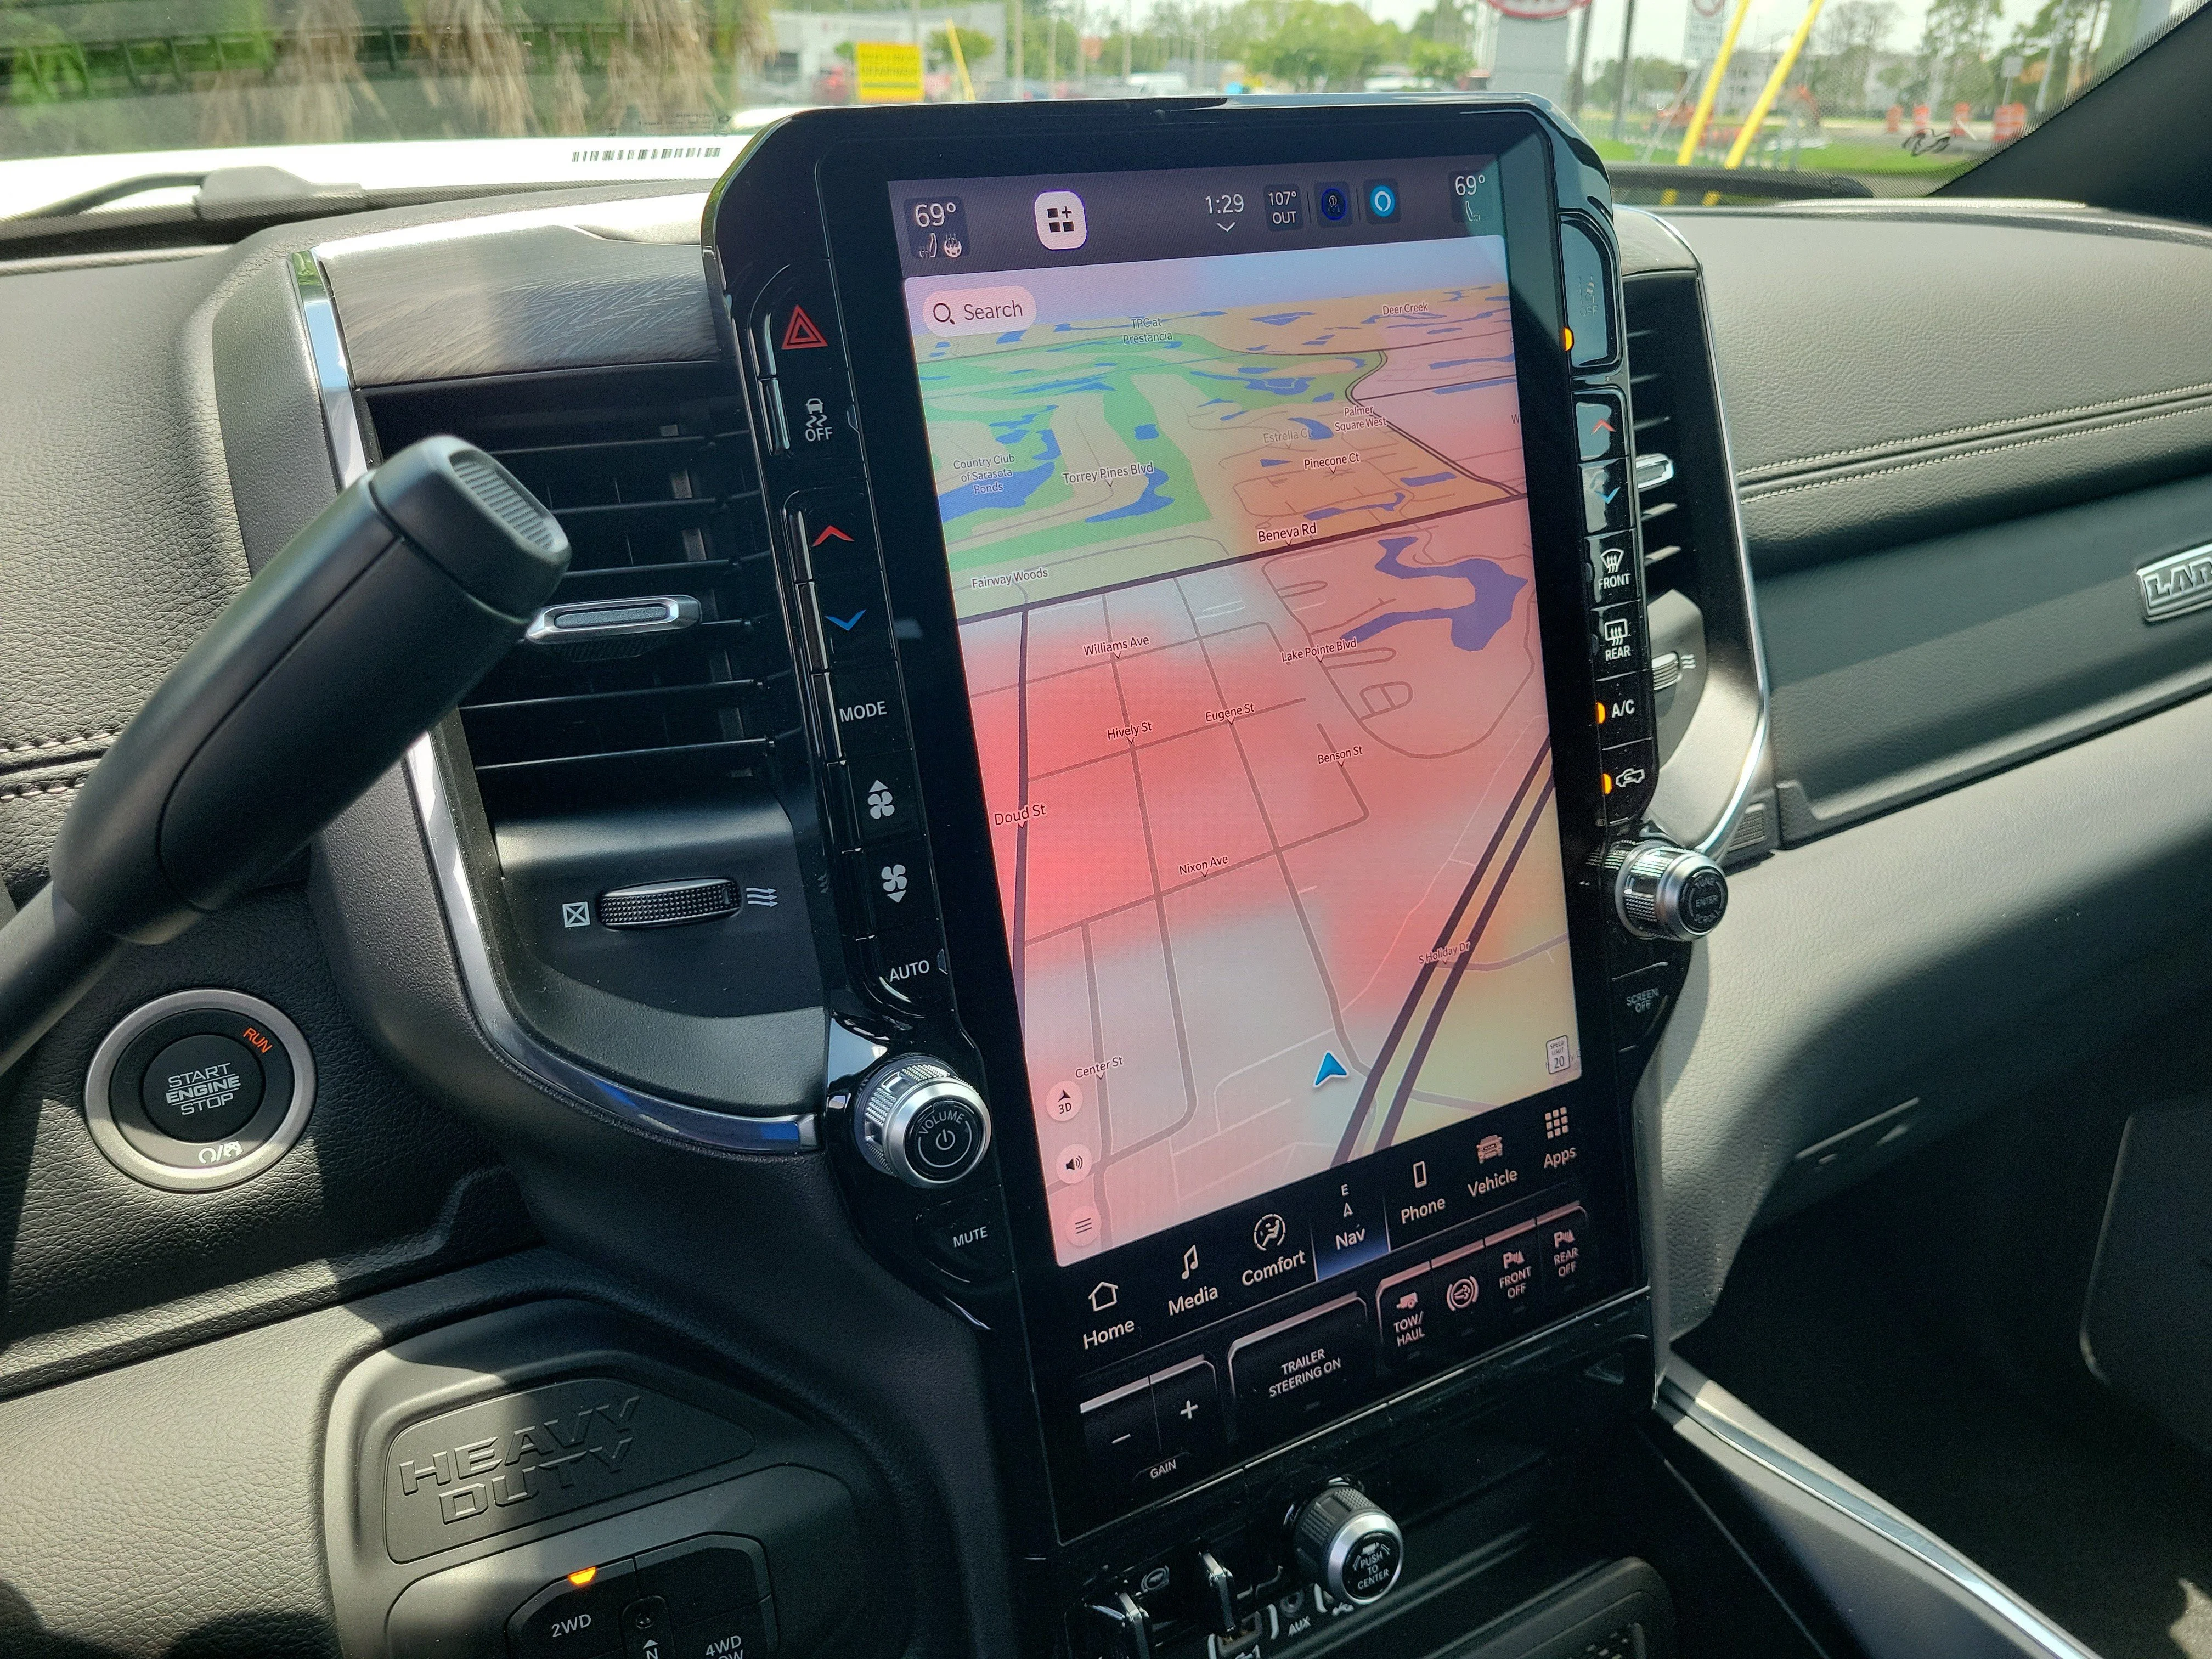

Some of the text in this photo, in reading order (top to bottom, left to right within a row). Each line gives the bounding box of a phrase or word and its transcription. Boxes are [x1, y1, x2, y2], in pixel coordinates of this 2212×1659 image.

[1455, 174, 1486, 196] 69°
[1205, 194, 1244, 215] 1:29
[1268, 191, 1297, 206] 107°
[915, 201, 957, 227] 69°
[1272, 211, 1297, 225] OUT
[963, 300, 1023, 321] Search
[1383, 302, 1429, 315] Deer Creek
[1580, 305, 1598, 317] OFF
[1130, 318, 1162, 329] TPC at
[1123, 331, 1173, 345] Prestancia
[1344, 405, 1374, 417] Palmer
[805, 427, 833, 442] OFF
[1334, 416, 1387, 432] Square West
[1263, 428, 1312, 443] Estrella Ct
[953, 454, 1015, 470] Country Club
[1304, 453, 1359, 470] Pinecone Ct
[961, 469, 1013, 482] of Sarasota
[1063, 462, 1154, 486] Torrey Pines Blvd
[974, 482, 1003, 494] Ponds
[1258, 523, 1317, 543] Beneva Rd
[972, 568, 1048, 589] Fairway Woods
[1598, 573, 1631, 590] FRONT
[1084, 636, 1149, 657] Williams Ave
[1282, 638, 1357, 663] Lake Pointe Blvd
[1605, 646, 1631, 661] REAR
[839, 701, 887, 723] MODE
[1206, 703, 1255, 723] Eugene St
[1612, 699, 1635, 718] A/C
[1107, 722, 1153, 740] Hively St
[1317, 746, 1363, 764] Benson St
[994, 804, 1046, 826] Doud St
[1179, 855, 1228, 876] Nixon Ave
[1419, 941, 1470, 964] S Holiday Dr
[889, 960, 929, 982] AUTO
[1626, 988, 1659, 1006] SCREEN
[1635, 1000, 1652, 1013] OFF
[242, 1027, 273, 1054] RUN
[1550, 1040, 1564, 1049] SPEED
[1551, 1047, 1564, 1056] LIMIT
[1075, 1056, 1123, 1079] Center St
[1554, 1056, 1565, 1069] 20
[168, 1062, 231, 1088] START
[166, 1075, 241, 1104] ENGINE
[181, 1092, 234, 1115] STOP
[1059, 1102, 1072, 1114] 3D
[919, 1110, 965, 1135] VOLUME
[1543, 1147, 1577, 1169] Apps
[1468, 1169, 1518, 1197] Vehicle
[1401, 1198, 1446, 1224] Phone
[953, 1226, 988, 1248] MUTE
[1335, 1227, 1366, 1250] Nav
[1554, 1247, 1579, 1266] REAR
[1242, 1250, 1306, 1286] Comfort
[1499, 1266, 1532, 1289] FRONT
[1558, 1262, 1577, 1277] OFF
[1168, 1286, 1218, 1316] Media
[1508, 1284, 1527, 1299] OFF
[1393, 1311, 1424, 1334] TOW/
[1082, 1320, 1135, 1350] Home
[1397, 1327, 1426, 1347] HAUL
[1281, 1348, 1325, 1375] TRAILER
[1269, 1358, 1342, 1398] STEERING ON
[400, 1395, 641, 1496] HEAVY
[1149, 1459, 1177, 1479] GAIN
[439, 1436, 633, 1525] DUTY
[1360, 1550, 1384, 1570] PUSH
[1367, 1564, 1379, 1576] TO
[1357, 1568, 1390, 1590] CENTER
[551, 1614, 592, 1638] 2WD
[1288, 1616, 1311, 1637] AUX
[706, 1635, 741, 1656] 4WD
